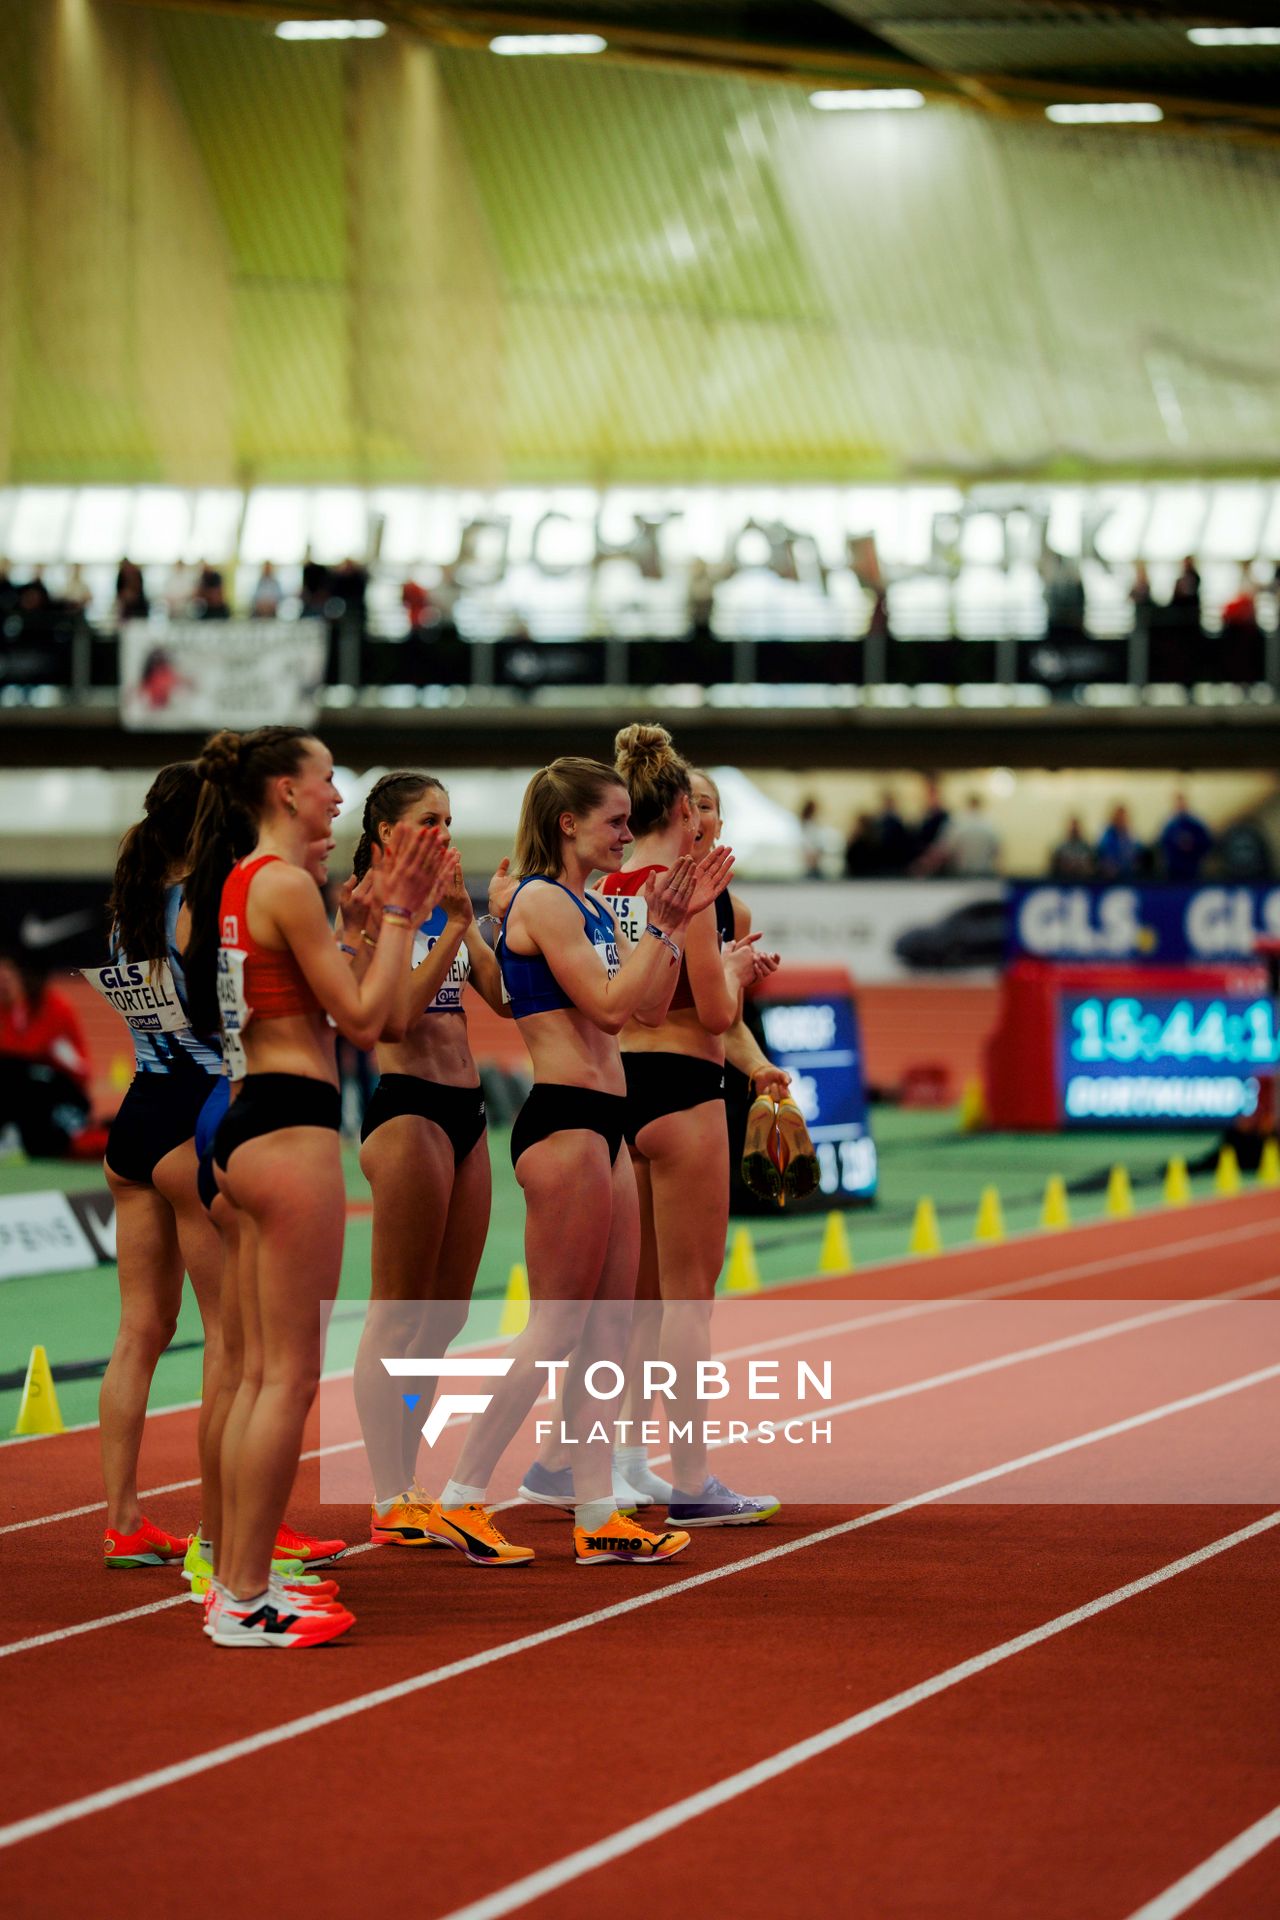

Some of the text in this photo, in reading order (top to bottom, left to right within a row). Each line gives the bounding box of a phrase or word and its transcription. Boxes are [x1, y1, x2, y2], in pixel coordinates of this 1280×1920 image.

[105, 984, 175, 1011] TORTELL
[1071, 998, 1280, 1063] 15:44:1
[582, 1536, 643, 1551] NITRO
